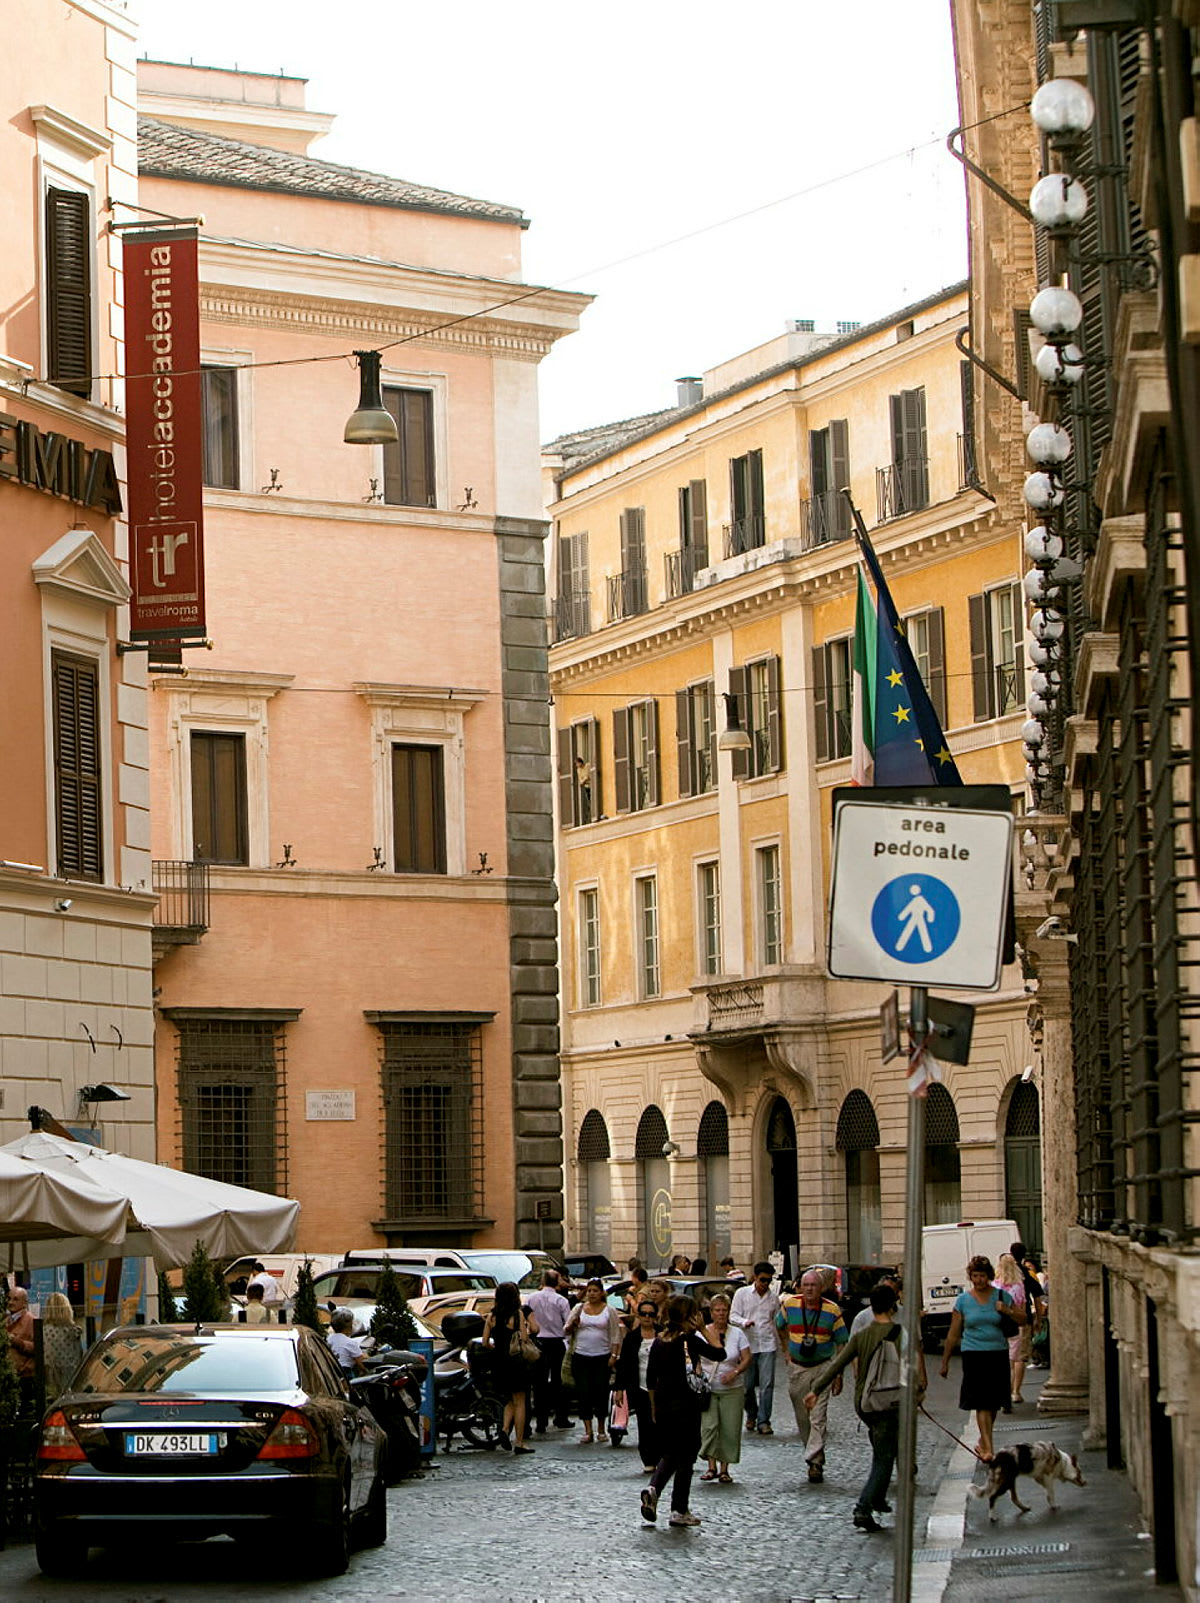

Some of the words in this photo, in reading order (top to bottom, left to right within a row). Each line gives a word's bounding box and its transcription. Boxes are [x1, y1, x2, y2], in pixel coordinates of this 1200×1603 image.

[145, 532, 188, 588] tr
[137, 605, 198, 619] travelroma
[901, 818, 945, 834] area
[873, 840, 970, 861] pedonale
[136, 1436, 154, 1451] DK
[160, 1436, 208, 1451] 493LL
